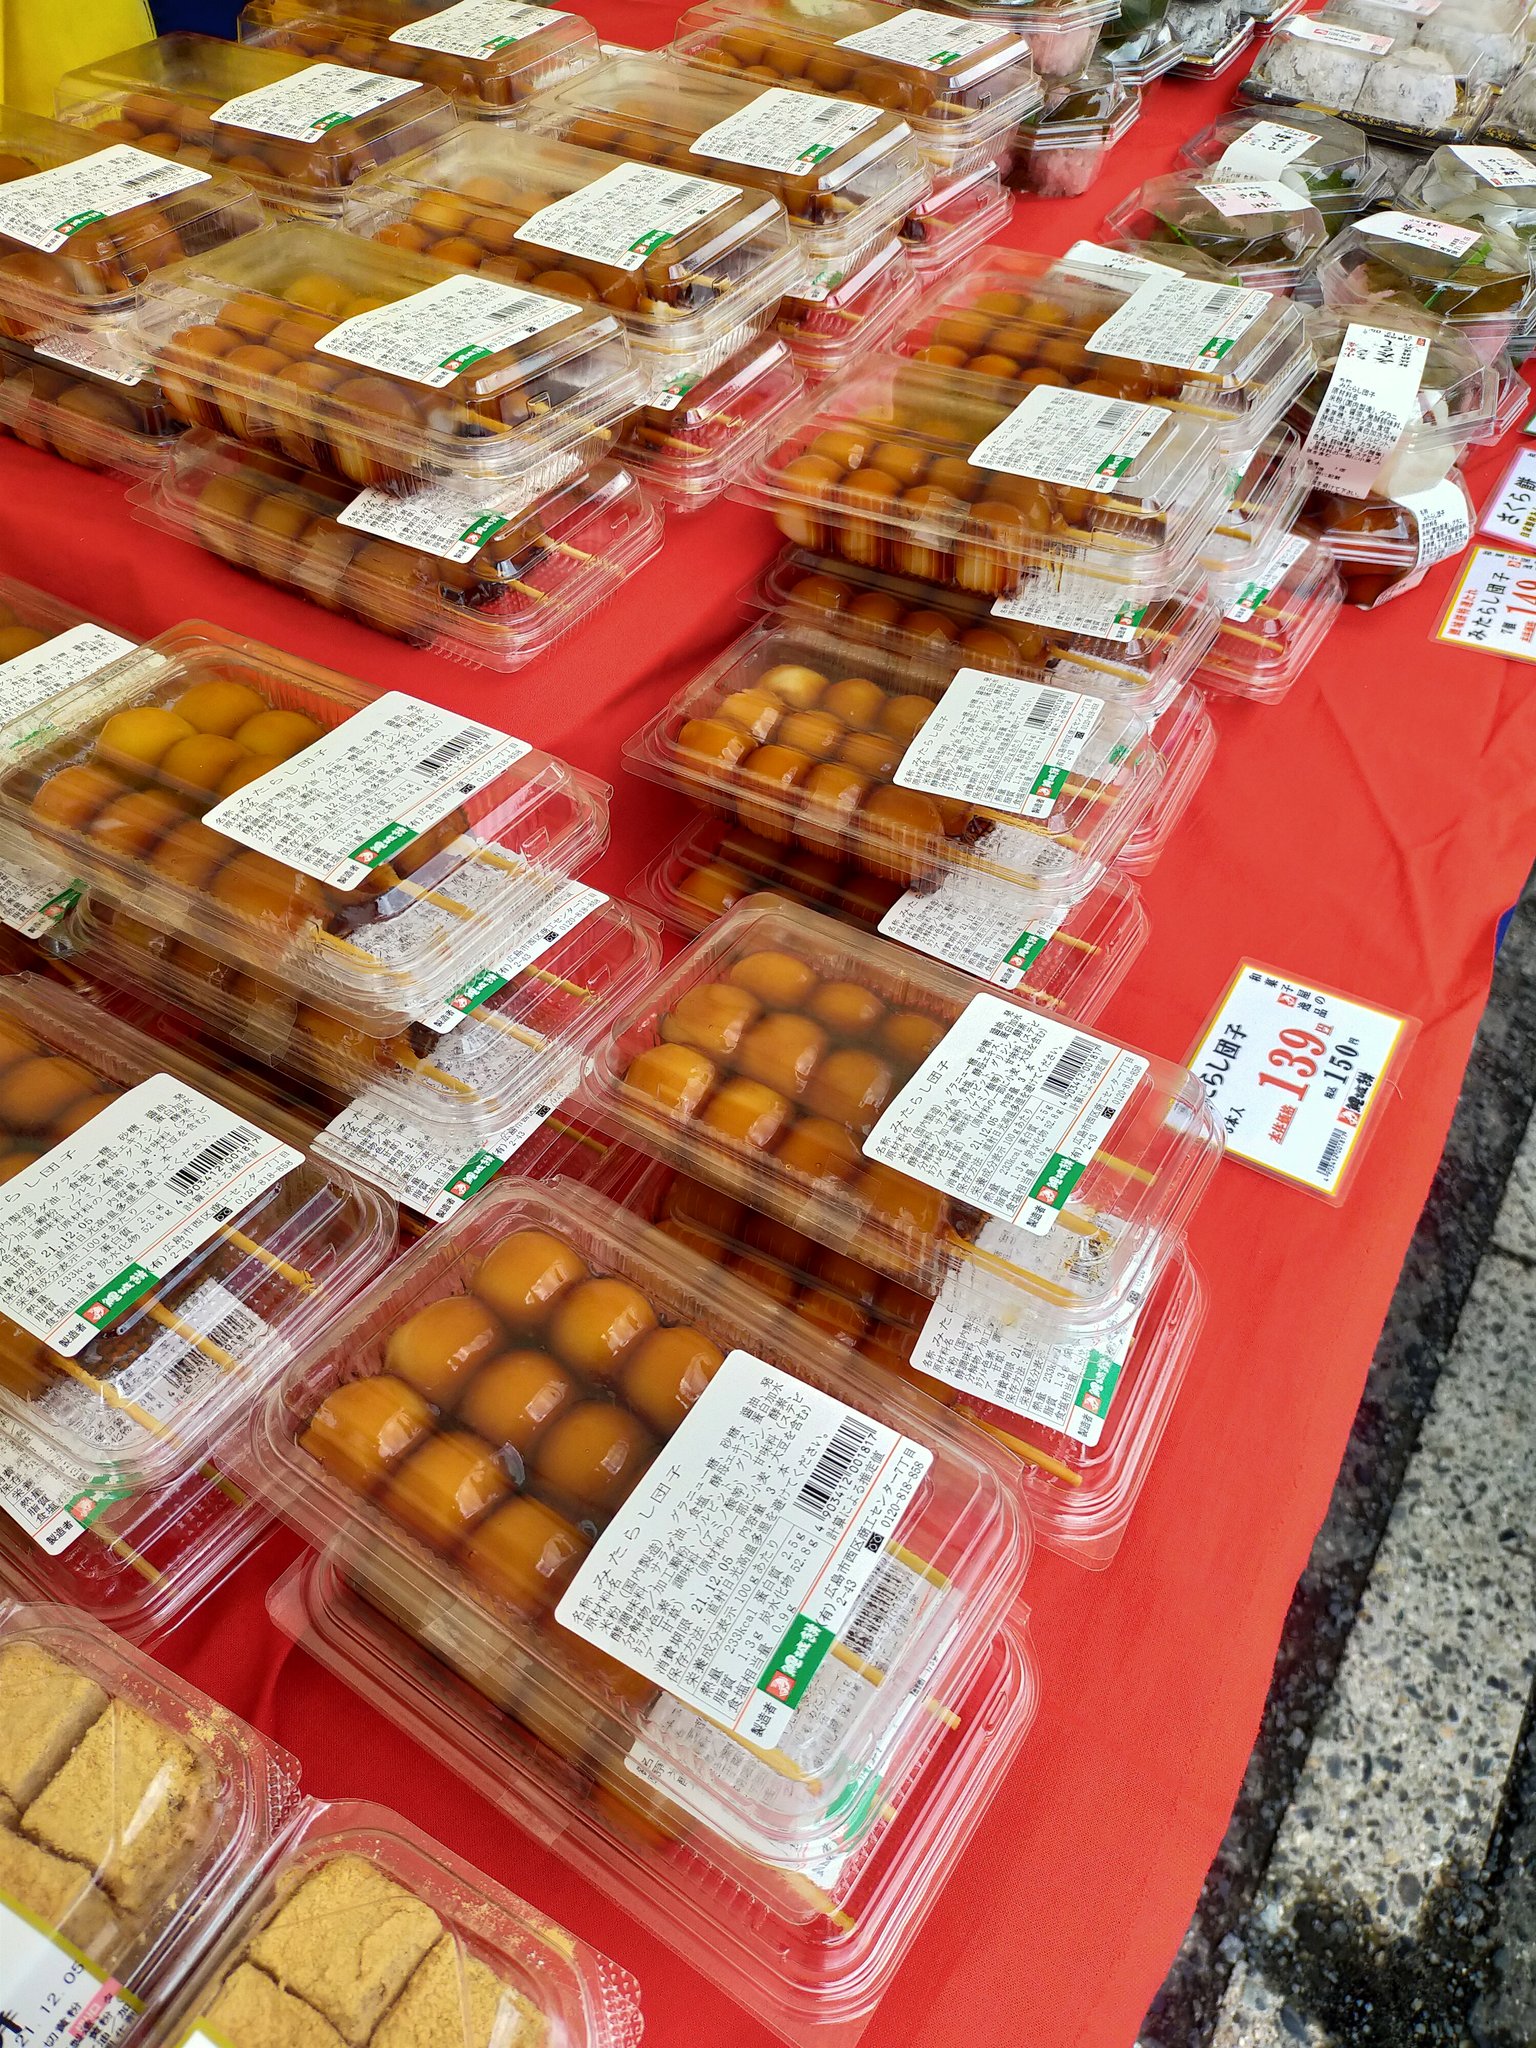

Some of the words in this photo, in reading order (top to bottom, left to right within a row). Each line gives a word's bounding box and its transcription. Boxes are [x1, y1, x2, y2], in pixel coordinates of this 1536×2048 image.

[1331, 387, 1358, 401] 原材料名
[1340, 383, 1375, 398] みたらし団子
[1497, 477, 1536, 525] さくら餅
[1468, 572, 1511, 641] みたらし団子
[211, 809, 236, 824] 名称
[234, 747, 330, 807] みたらし団子
[220, 800, 260, 829] 原材料名
[269, 821, 309, 852] 消費期限
[309, 792, 353, 822] 21.12.05
[334, 864, 361, 884] 製造者
[1247, 971, 1326, 1005] 和菓子屋の
[1314, 1021, 1333, 1035] 円
[1347, 1036, 1359, 1045] 円
[1068, 1056, 1110, 1111] 計算による推定値
[1253, 1023, 1330, 1103] 139
[1322, 1042, 1359, 1084] 150
[872, 1135, 893, 1156] 名称
[887, 1059, 951, 1134] みたらし団子
[1083, 1133, 1098, 1149] 2-43
[1111, 1064, 1142, 1105] 0120-818-858
[1323, 1084, 1337, 1099] 税込
[882, 1124, 915, 1160] 原材料名
[943, 1151, 974, 1188] 消費期限
[969, 1115, 999, 1150] 21.12.05
[999, 1085, 1020, 1108] 内容量
[1266, 1102, 1296, 1143] 本体価格
[0, 1147, 81, 1210] らし団子
[179, 1148, 262, 1212] 計算による推定値
[968, 1144, 1009, 1196] 栄養成分表示
[981, 1182, 1001, 1203] 熱量
[998, 1147, 1023, 1175] 233kcal
[1018, 1123, 1039, 1146] 蛋白質
[992, 1187, 1012, 1208] 脂質
[1023, 1128, 1049, 1159] 炭水化物
[169, 1239, 194, 1258] 2-43
[233, 1158, 293, 1205] 0120-818-858
[433, 1196, 458, 1218] 製造者
[1003, 1168, 1038, 1212] 食塩相当量
[1025, 1204, 1046, 1227] 製造者
[38, 1216, 94, 1258] 21.12.05
[103, 1180, 140, 1207] 内容量
[12, 1252, 82, 1308] 栄養成分表示
[22, 1293, 51, 1315] 熱量
[55, 1255, 98, 1287] 233kcal
[98, 1227, 134, 1253] 蛋白質
[31, 1300, 60, 1322] 脂質
[95, 1232, 143, 1269] 炭水化物
[40, 1280, 103, 1328] 食塩相当量
[57, 1322, 89, 1348] 製造者
[920, 1348, 937, 1369] 名称
[931, 1336, 955, 1373] 原材料名
[992, 1360, 1018, 1399] 消費期限
[1030, 1390, 1046, 1411] 熱量
[1041, 1395, 1058, 1416] 脂質
[1075, 1412, 1094, 1437] 製造者
[825, 1449, 885, 1541] 計算による推定値
[44, 1518, 74, 1545] 製造者
[569, 1593, 595, 1623] 名称
[591, 1461, 685, 1591] みたらし団子
[835, 1578, 858, 1606] 2-43
[879, 1459, 924, 1528] 0120-818-858
[581, 1575, 622, 1631] 原材料名
[653, 1617, 695, 1675] 消費期限
[691, 1553, 734, 1615] 21.12.05
[737, 1501, 767, 1540] 内容量
[699, 1665, 724, 1697] 熱量
[724, 1607, 758, 1655] 233kcal
[754, 1565, 784, 1605] 蛋白質
[780, 1529, 805, 1561] 2.5g
[682, 1603, 739, 1687] 栄養成分表示
[711, 1673, 737, 1706] 脂質
[736, 1628, 763, 1663] 1.3g
[758, 1572, 796, 1626] 炭水化物
[789, 1536, 818, 1574] 52.8g
[724, 1641, 774, 1714] 食塩相当量
[770, 1601, 797, 1635] 0.9g
[749, 1700, 778, 1738] 製造者
